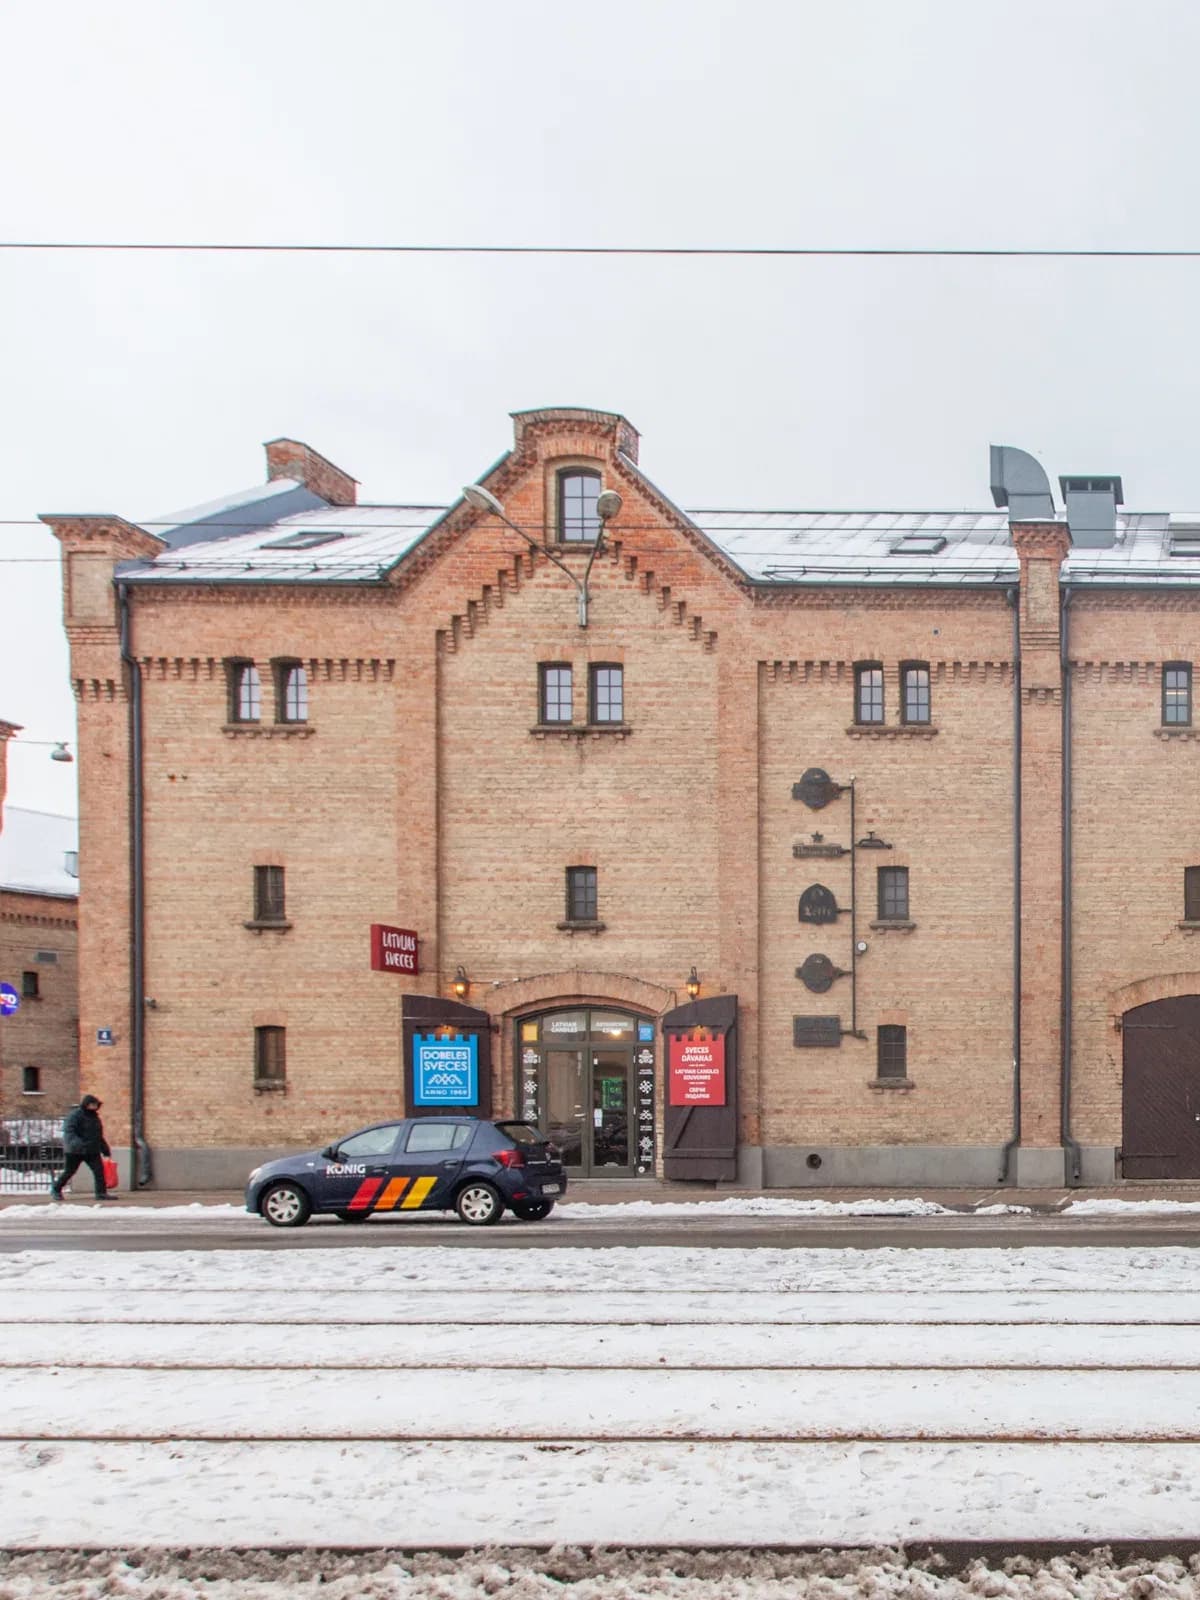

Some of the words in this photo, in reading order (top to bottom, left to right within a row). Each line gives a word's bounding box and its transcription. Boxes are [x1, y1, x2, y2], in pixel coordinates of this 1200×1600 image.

[385, 951, 414, 969] SVECES
[685, 1046, 709, 1054] SVECES
[423, 1051, 468, 1060] DOBELES
[423, 1061, 468, 1071] SVECES
